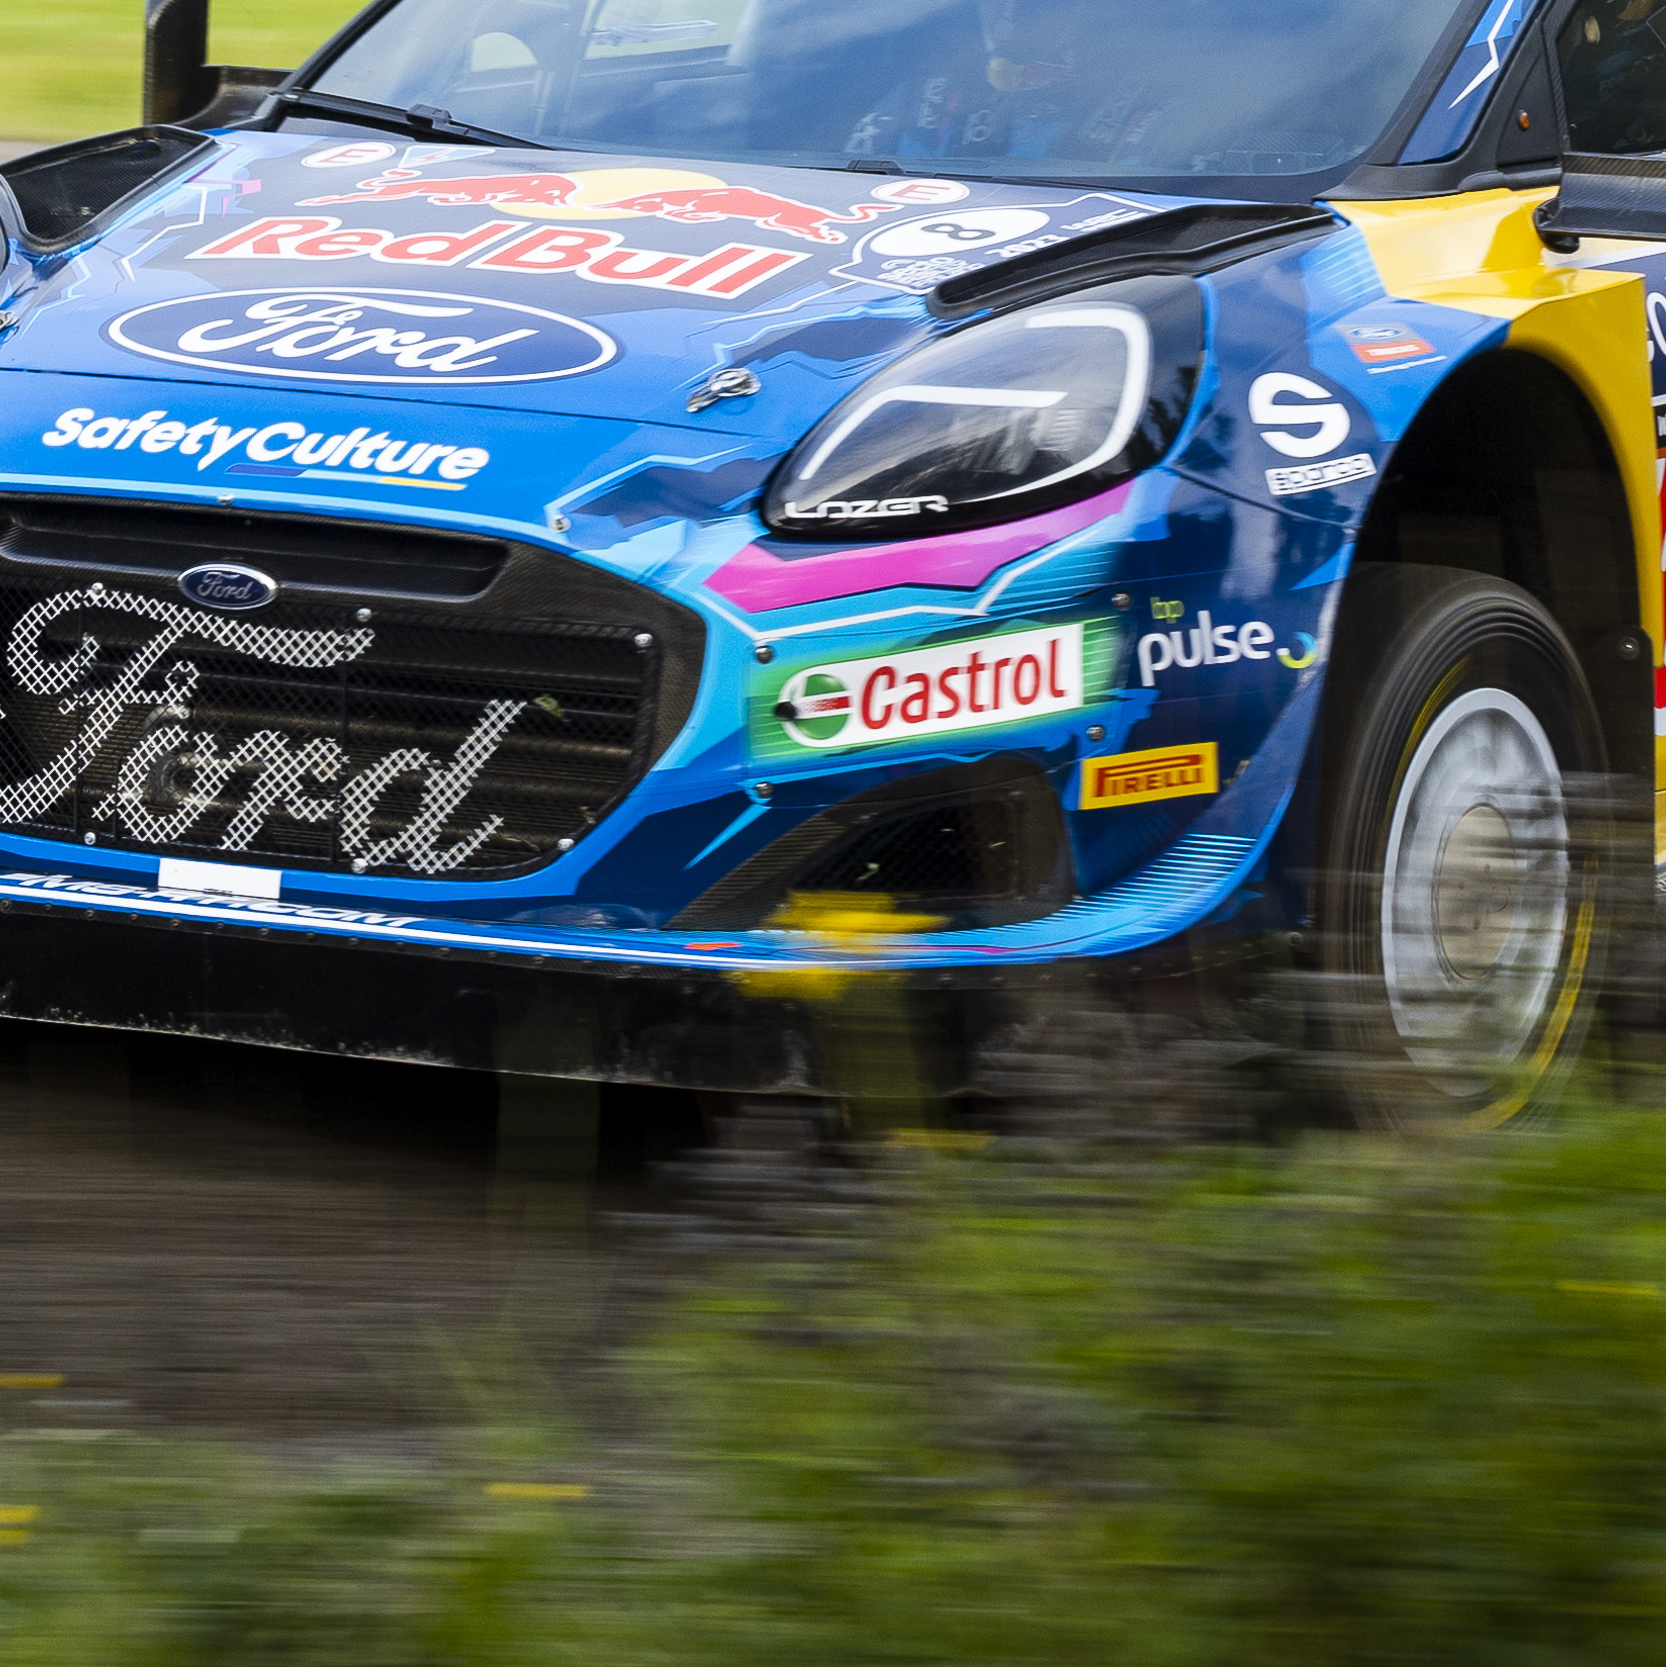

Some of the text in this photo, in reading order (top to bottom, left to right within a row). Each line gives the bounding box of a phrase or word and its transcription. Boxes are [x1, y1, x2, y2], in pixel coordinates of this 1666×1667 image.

[889, 183, 951, 202] E
[921, 222, 996, 241] 8
[199, 217, 508, 269] Red
[473, 226, 807, 298] Bull
[178, 293, 540, 373] Ford
[42, 407, 491, 480] SafetyCulture
[785, 494, 950, 520] LAZER
[196, 571, 254, 600] Ford
[1149, 596, 1185, 624] bp
[1137, 609, 1275, 687] pulse
[861, 637, 1069, 730] Castrol
[1094, 754, 1203, 799] PIRELLI
